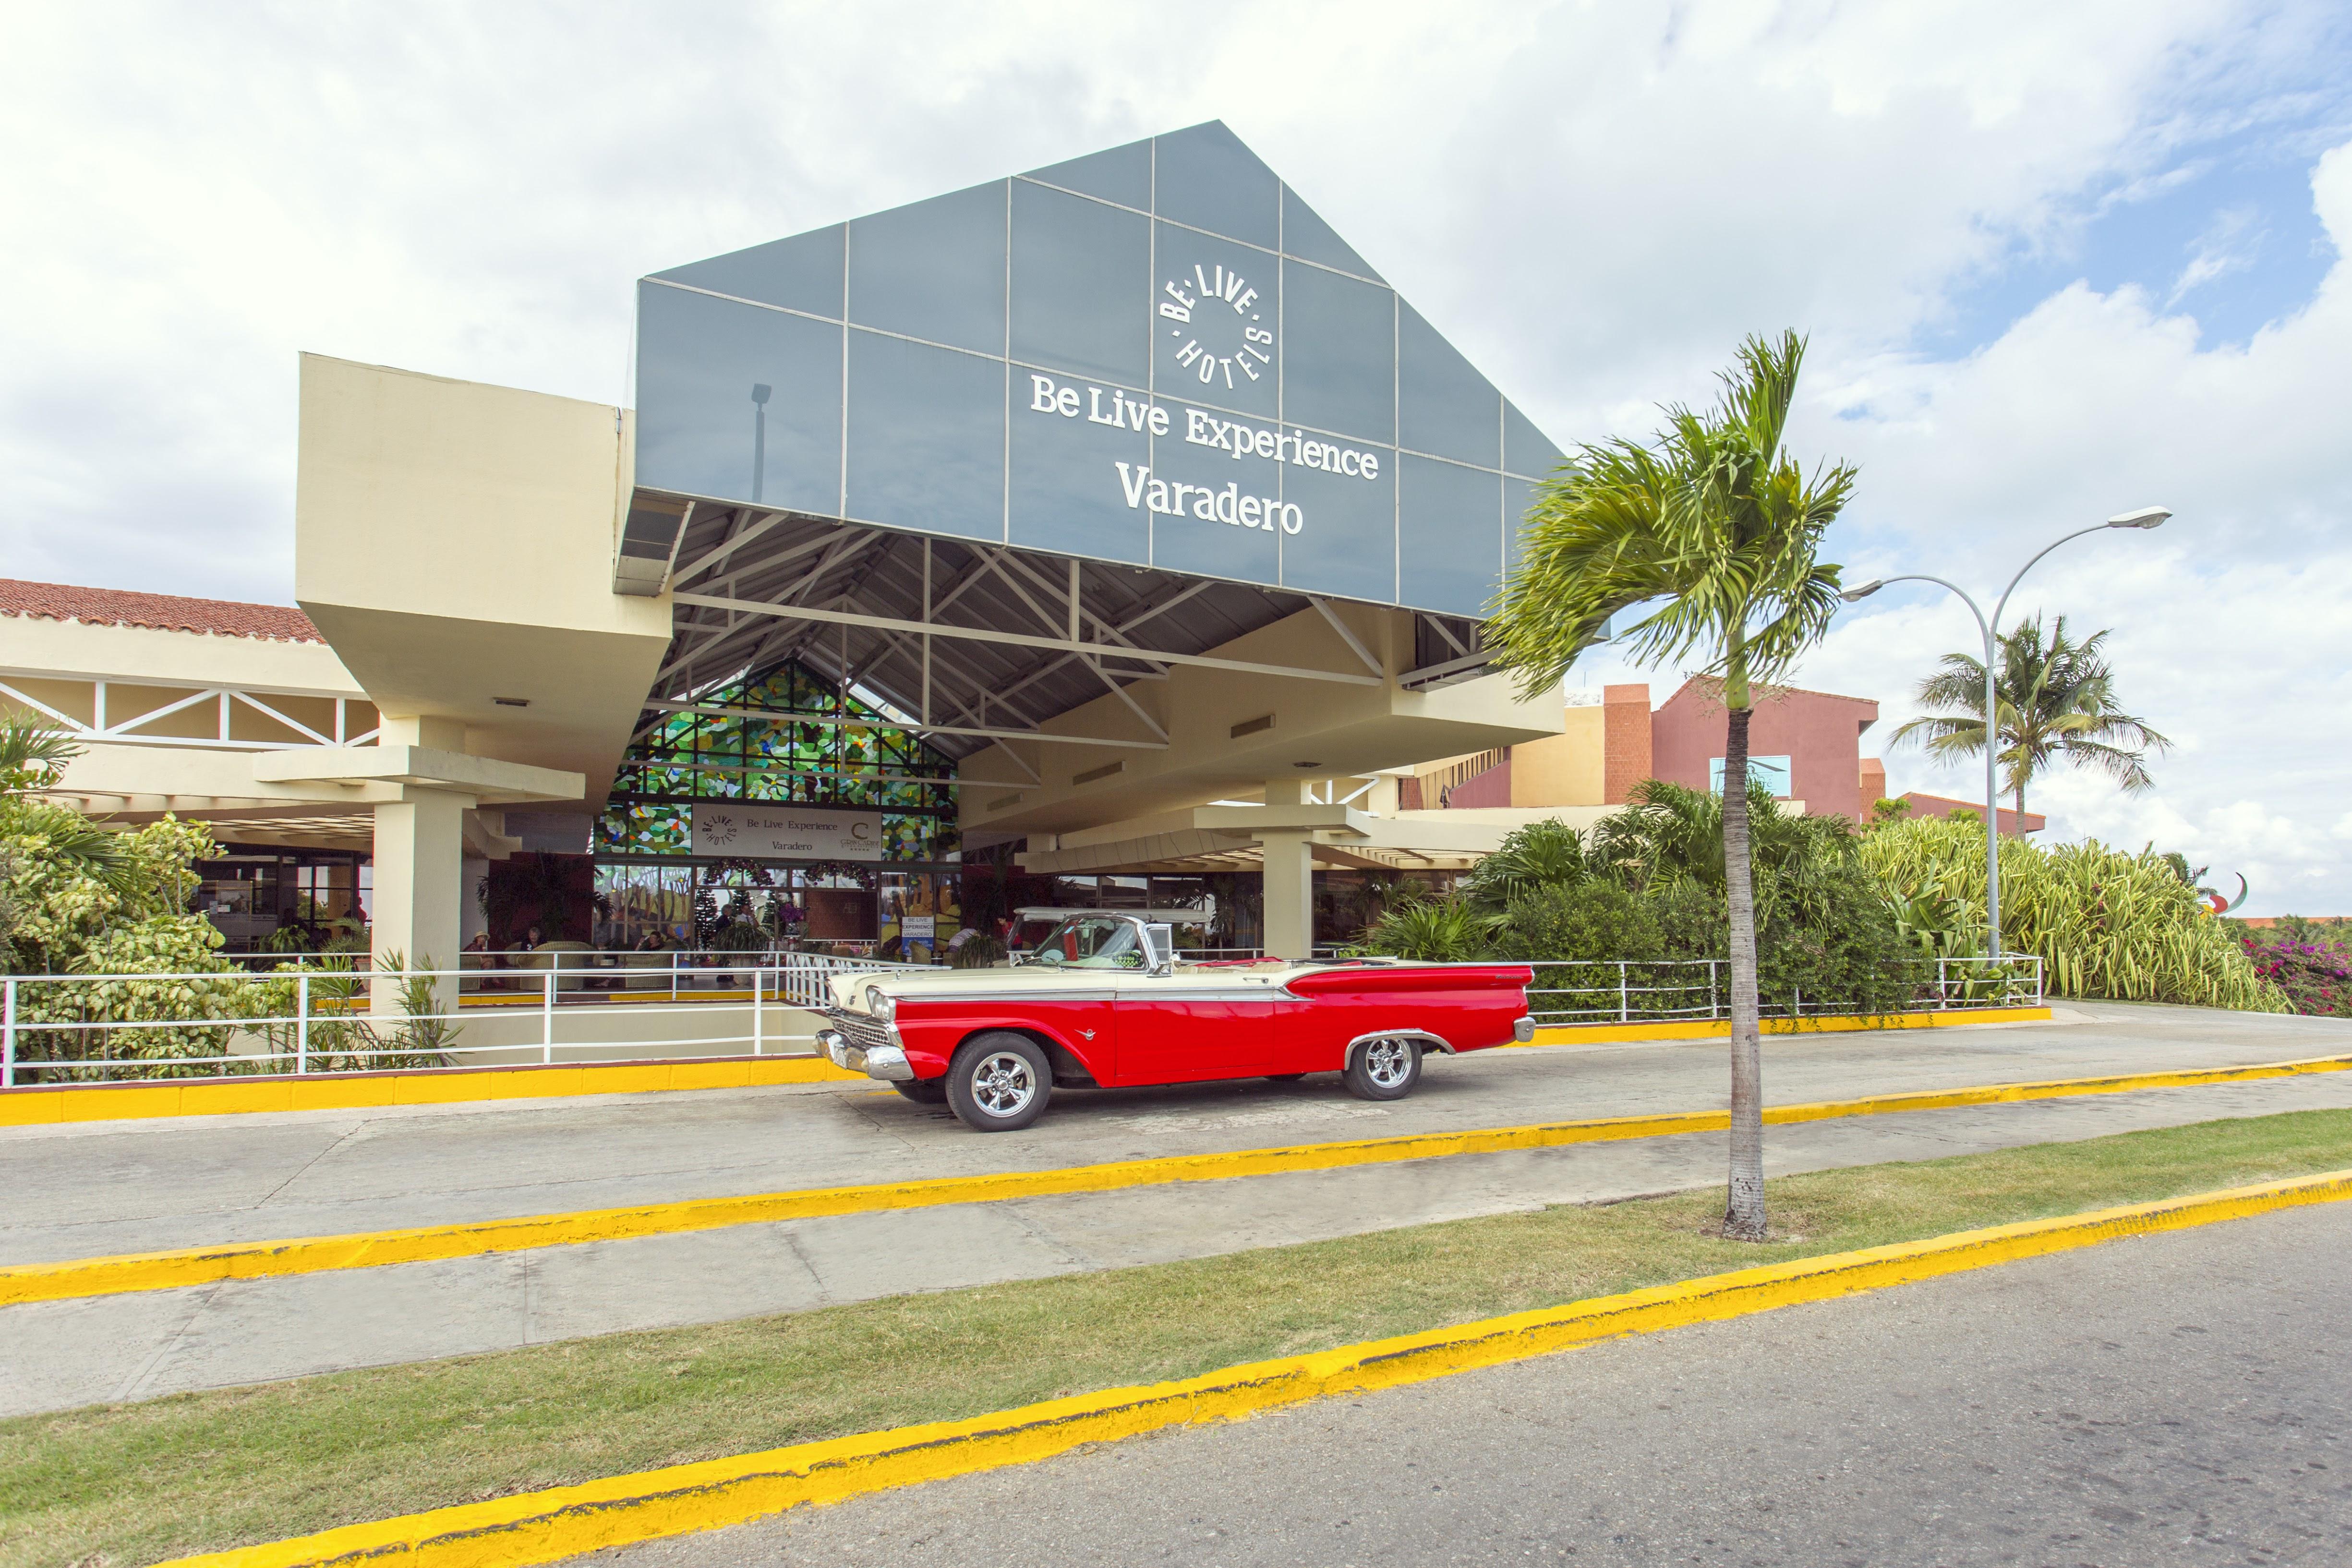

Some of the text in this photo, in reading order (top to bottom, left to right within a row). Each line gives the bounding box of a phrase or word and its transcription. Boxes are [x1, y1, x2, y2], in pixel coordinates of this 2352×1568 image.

[1159, 265, 1258, 323] BE LIVE
[1176, 327, 1272, 389] HOTELS
[1031, 374, 1379, 481] Be Live Experience
[1115, 462, 1303, 535] Varadero
[702, 816, 732, 832] BE LIVE
[706, 828, 737, 845] HOTELS
[747, 819, 838, 832] Be Live Experience
[772, 841, 813, 851] Varadero
